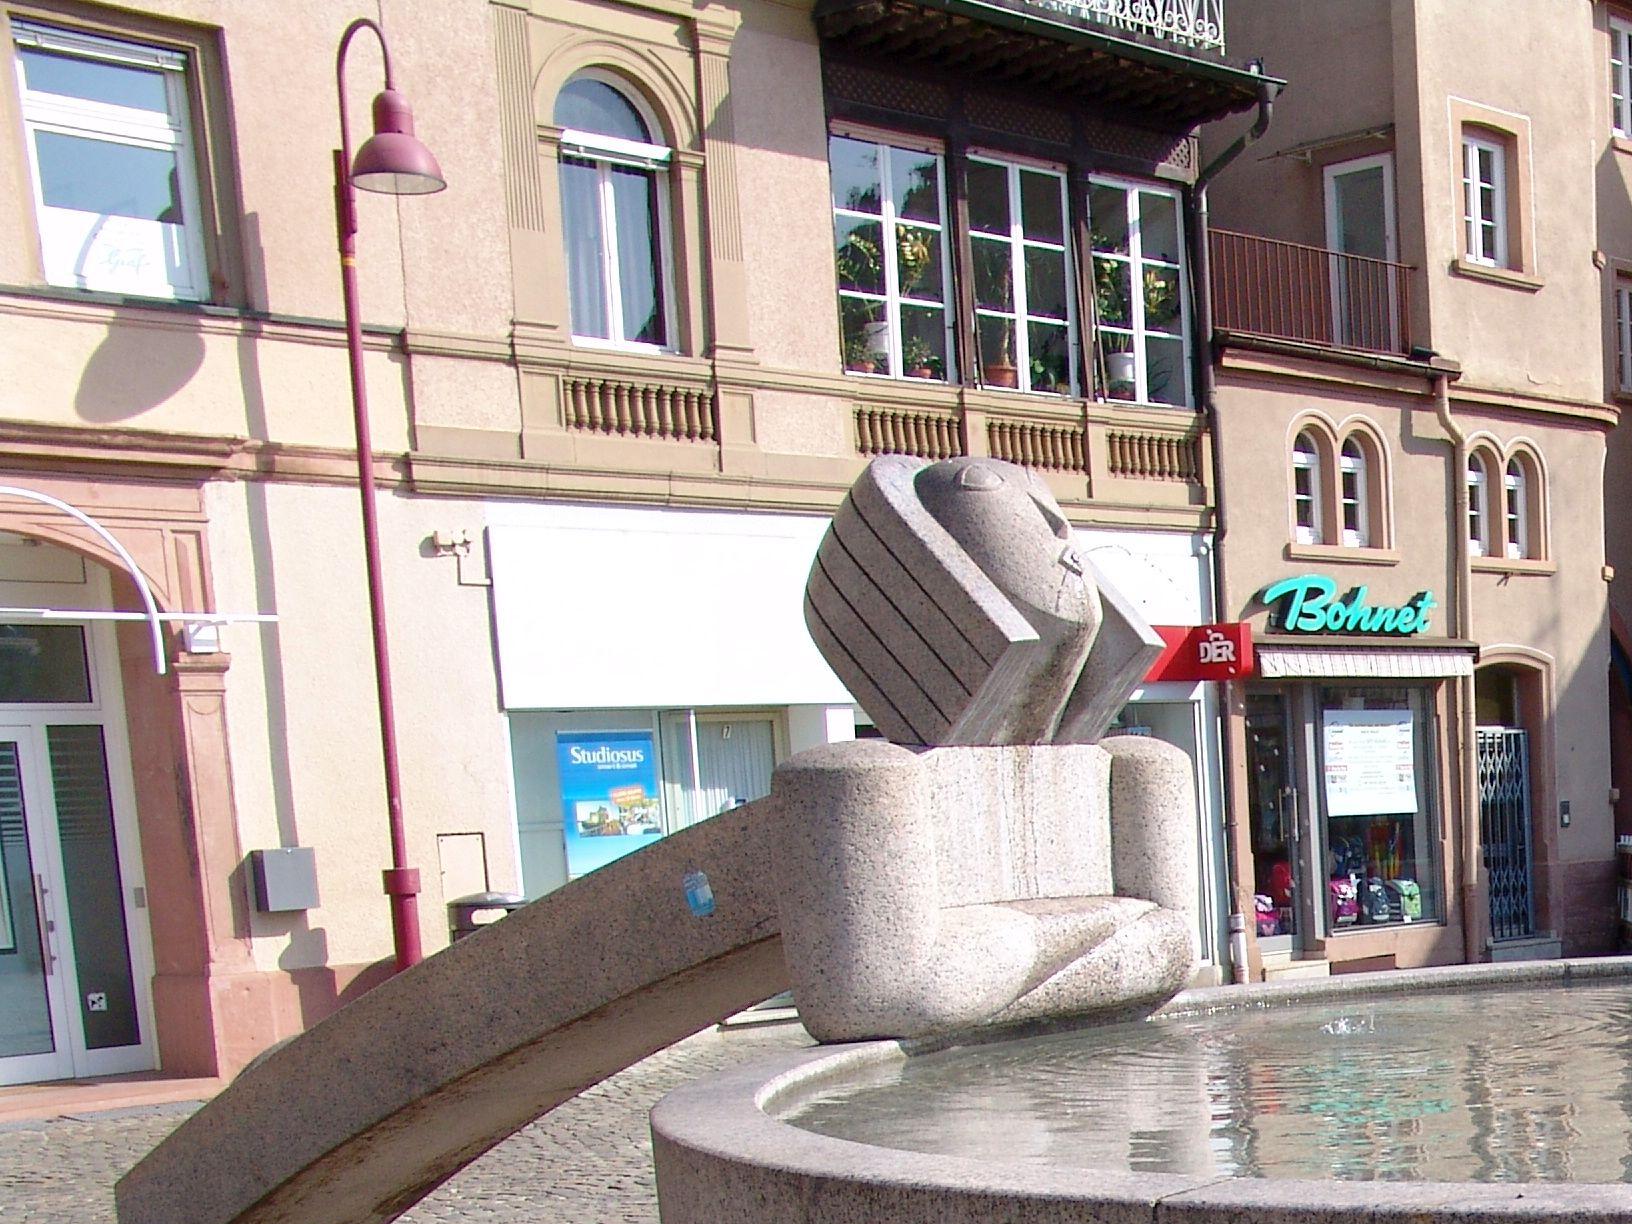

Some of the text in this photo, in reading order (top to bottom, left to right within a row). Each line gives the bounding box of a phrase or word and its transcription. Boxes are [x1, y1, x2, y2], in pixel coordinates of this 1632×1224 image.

[1264, 573, 1438, 633] Bohnet
[1199, 640, 1236, 664] DER
[571, 746, 644, 764] Studiosus
